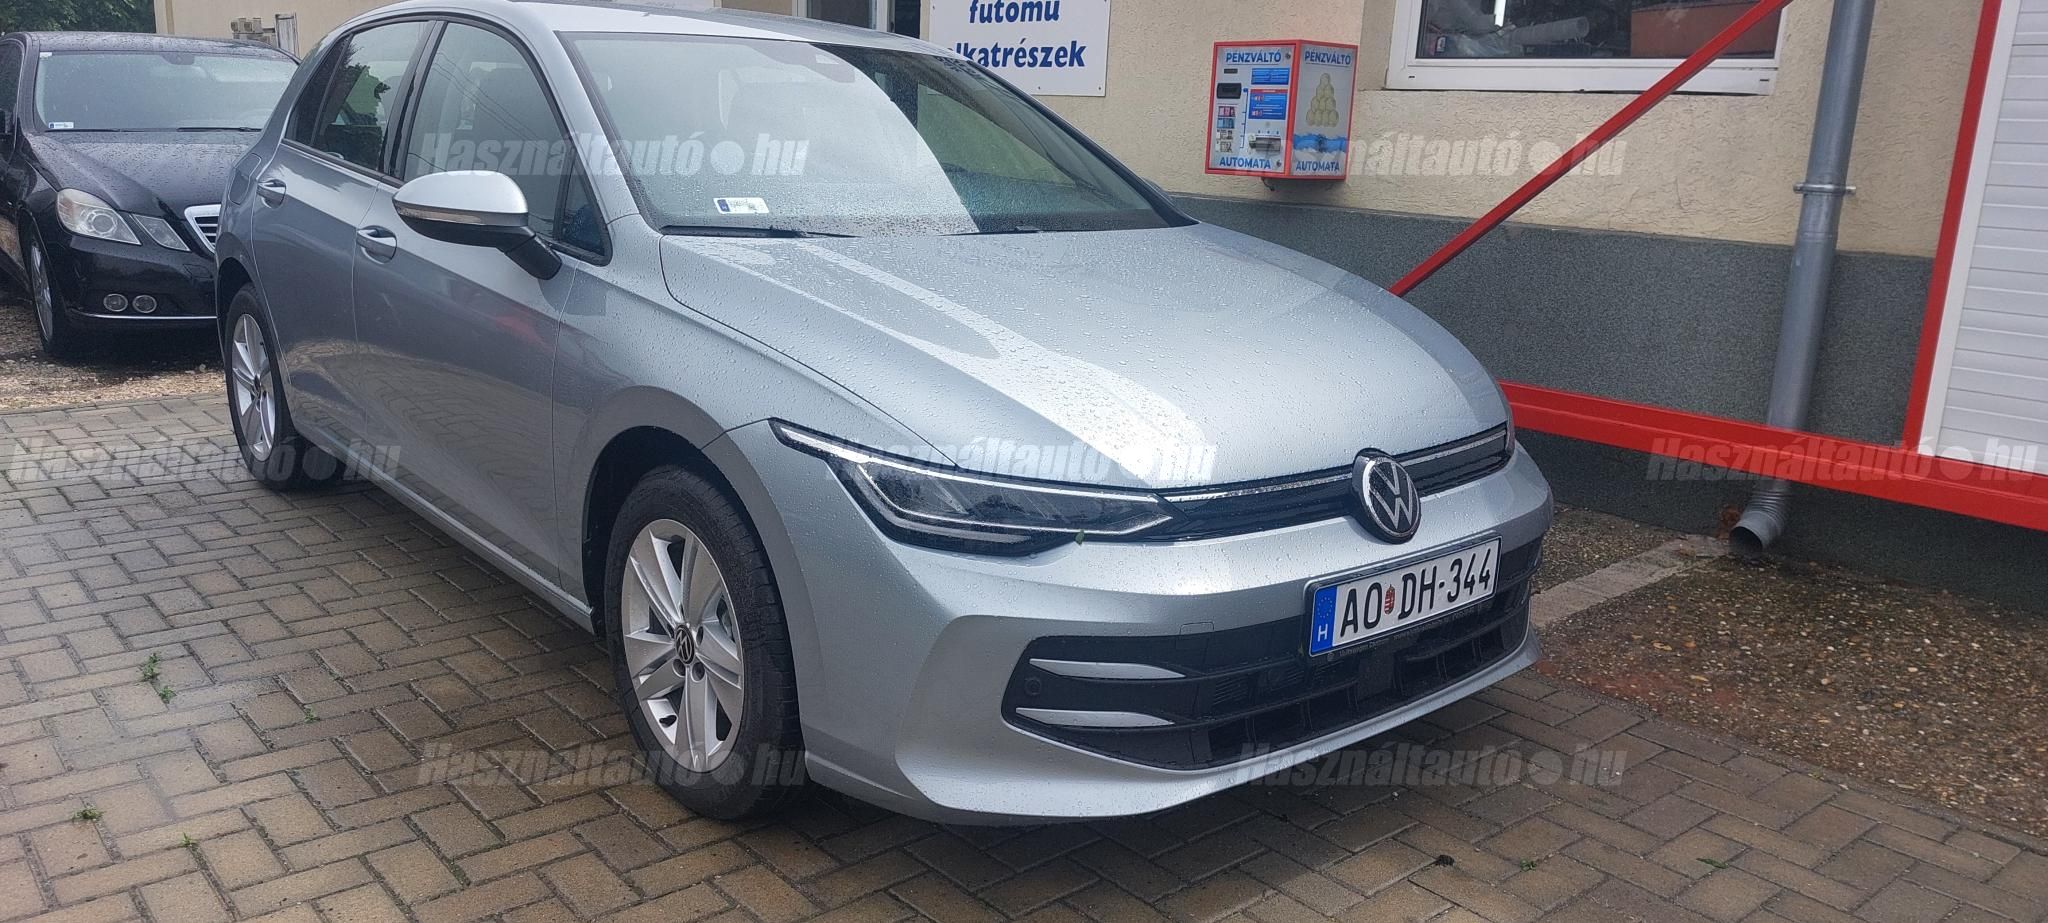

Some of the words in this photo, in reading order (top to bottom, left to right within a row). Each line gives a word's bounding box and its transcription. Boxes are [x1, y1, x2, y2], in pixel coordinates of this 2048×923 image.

[949, 38, 1086, 68] lkatrészek
[1219, 157, 1271, 169] AUTOMATA
[1296, 160, 1340, 173] AUTOMATA
[1397, 548, 1492, 620] DH-344
[1317, 623, 1329, 643] H
